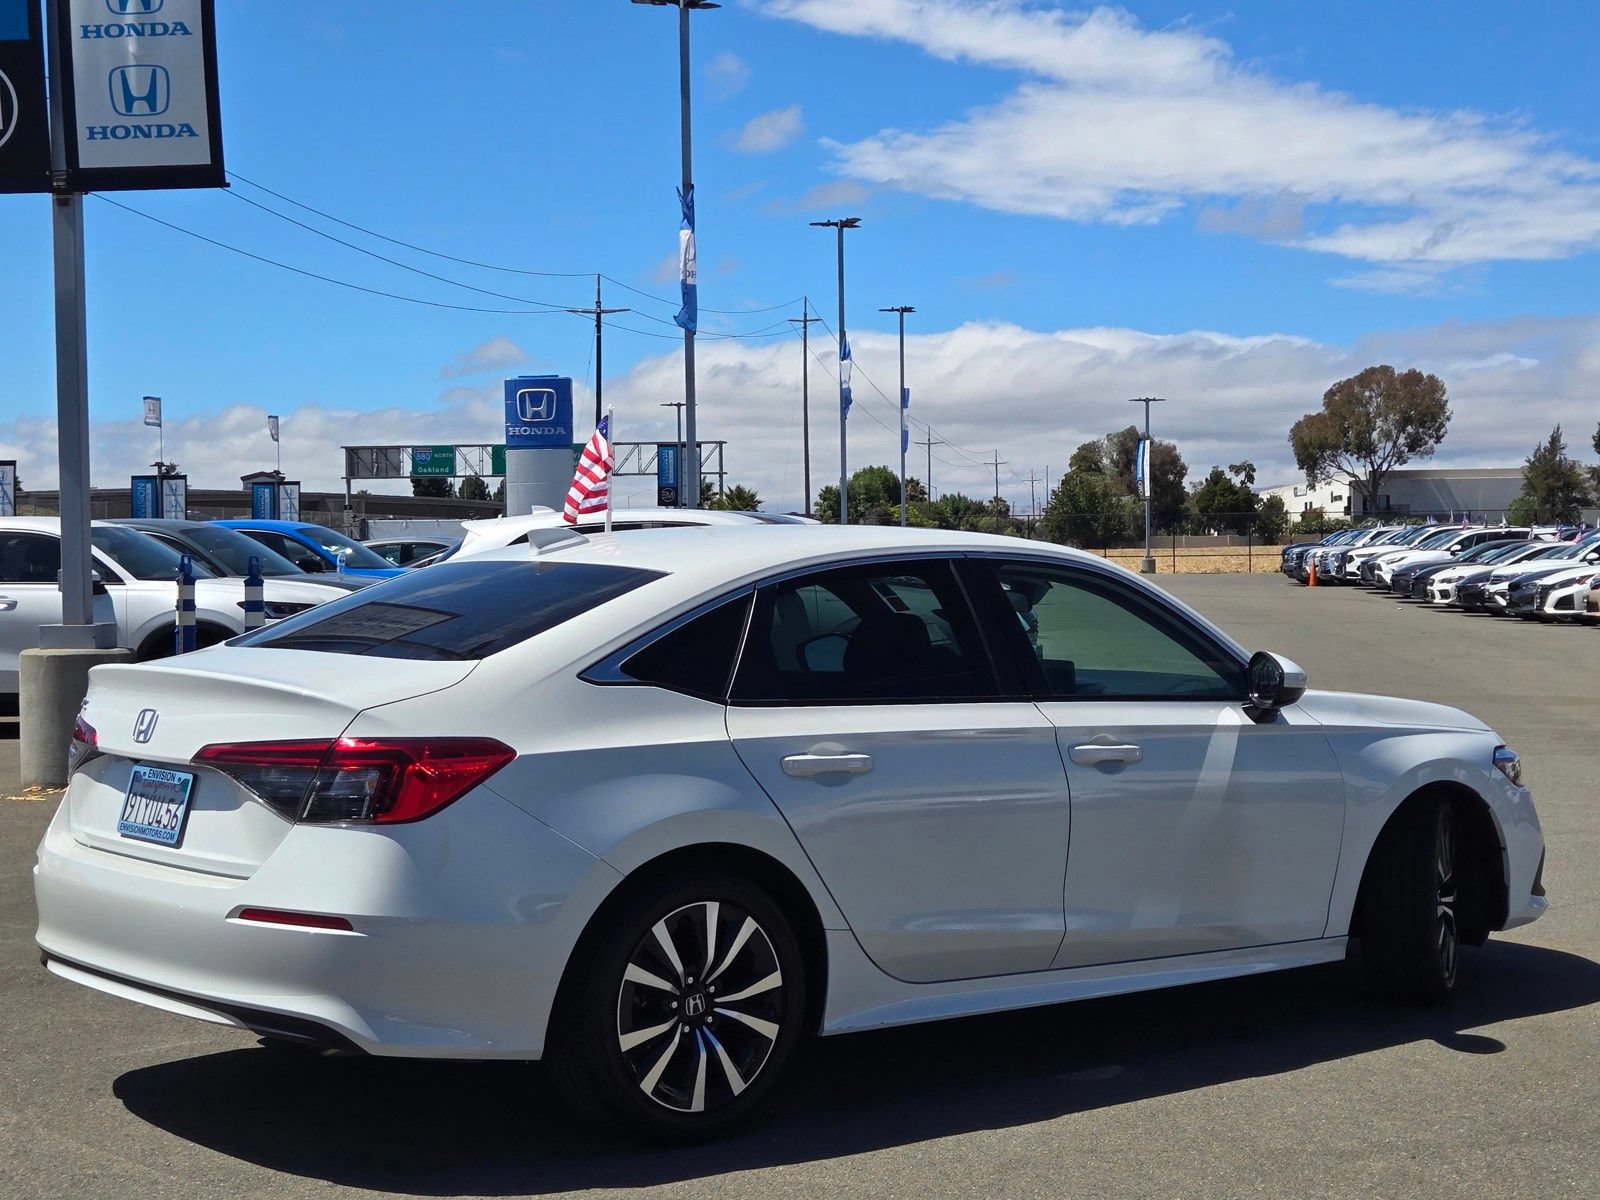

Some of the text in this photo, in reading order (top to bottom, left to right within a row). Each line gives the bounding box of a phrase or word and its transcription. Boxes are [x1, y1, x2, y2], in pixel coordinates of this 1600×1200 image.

[80, 22, 192, 39] HONDA
[86, 123, 199, 140] HONDA
[508, 426, 567, 435] HONDA
[416, 452, 431, 460] 880
[148, 769, 176, 782] ENVISION
[125, 792, 184, 830] 9TYU456
[120, 823, 176, 839] ENVISIONMOTORS.COM
